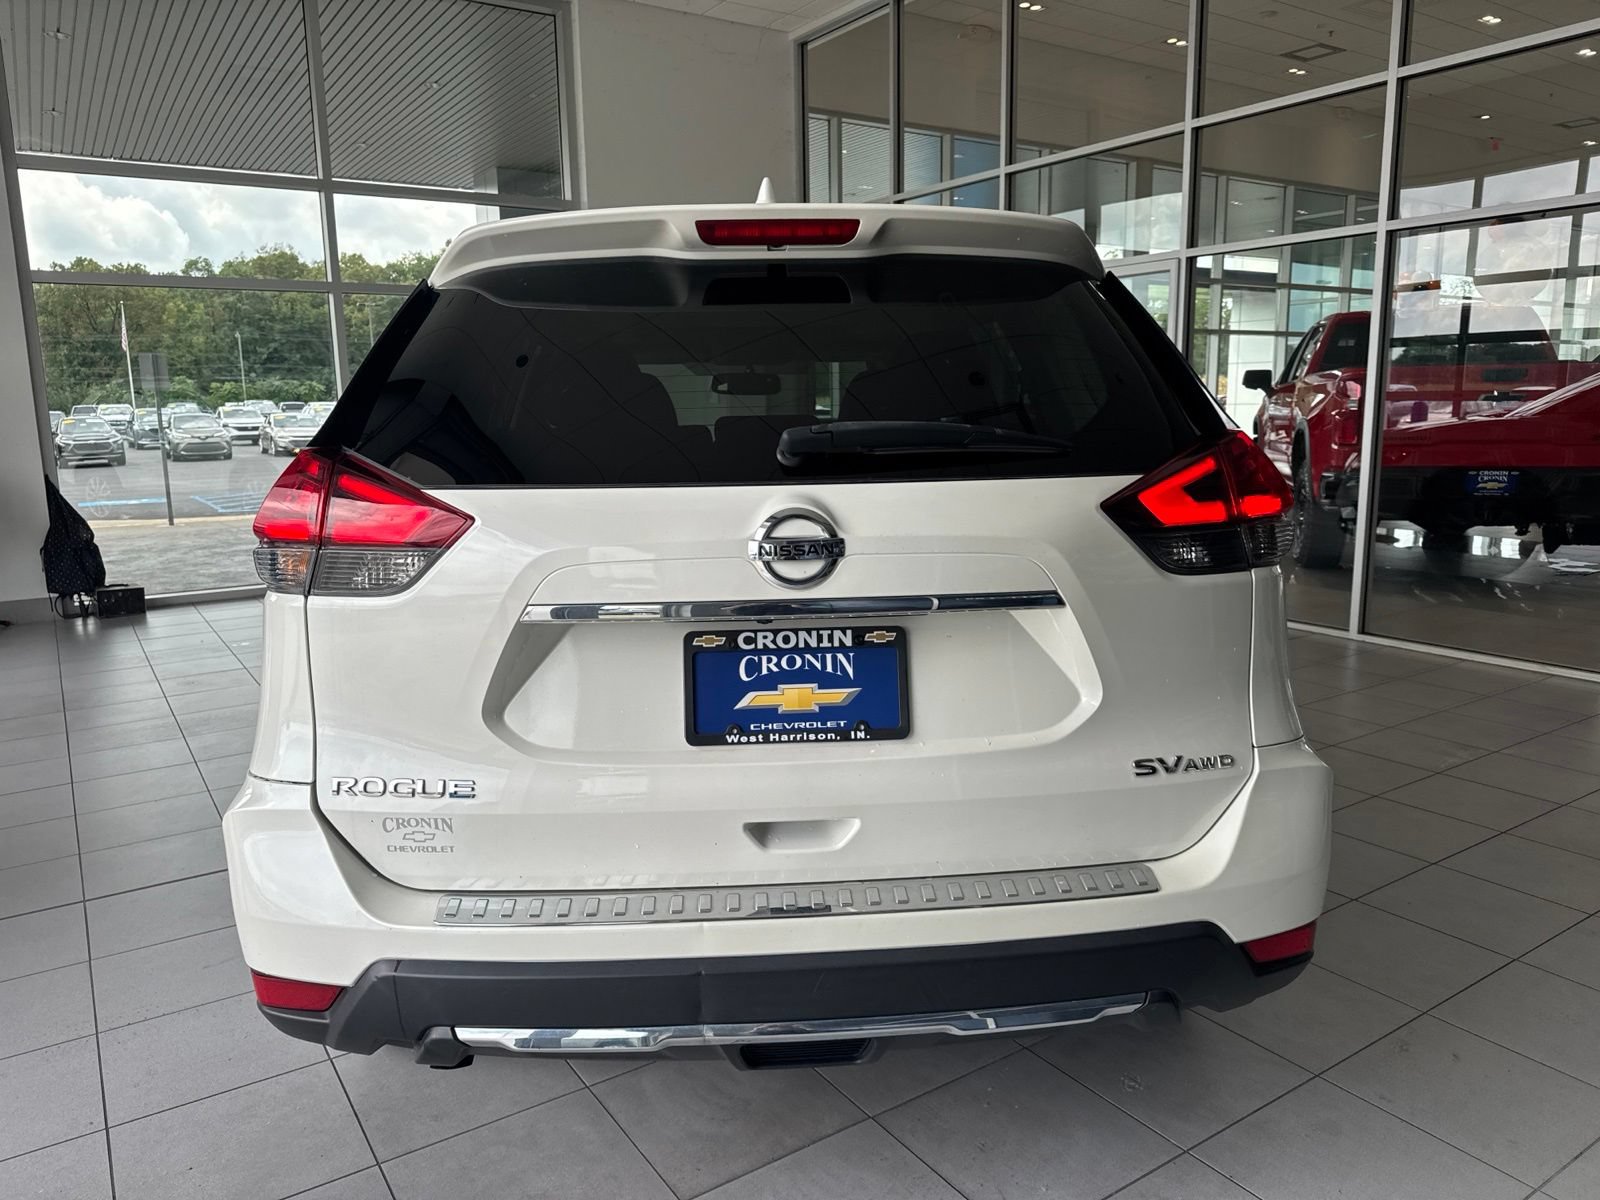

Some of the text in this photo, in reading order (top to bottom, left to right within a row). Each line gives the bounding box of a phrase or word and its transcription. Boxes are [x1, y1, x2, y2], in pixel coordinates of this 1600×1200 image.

[759, 543, 834, 557] NISSAN
[736, 629, 853, 650] CRONIN
[738, 652, 855, 682] CRONIN
[750, 720, 847, 731] CHEVROLET
[726, 731, 871, 744] West Harrison, IN.
[1132, 755, 1235, 777] SV AWD
[331, 776, 477, 799] ROGUE
[382, 816, 454, 834] CRONIN
[386, 845, 455, 854] CHEVROLET
